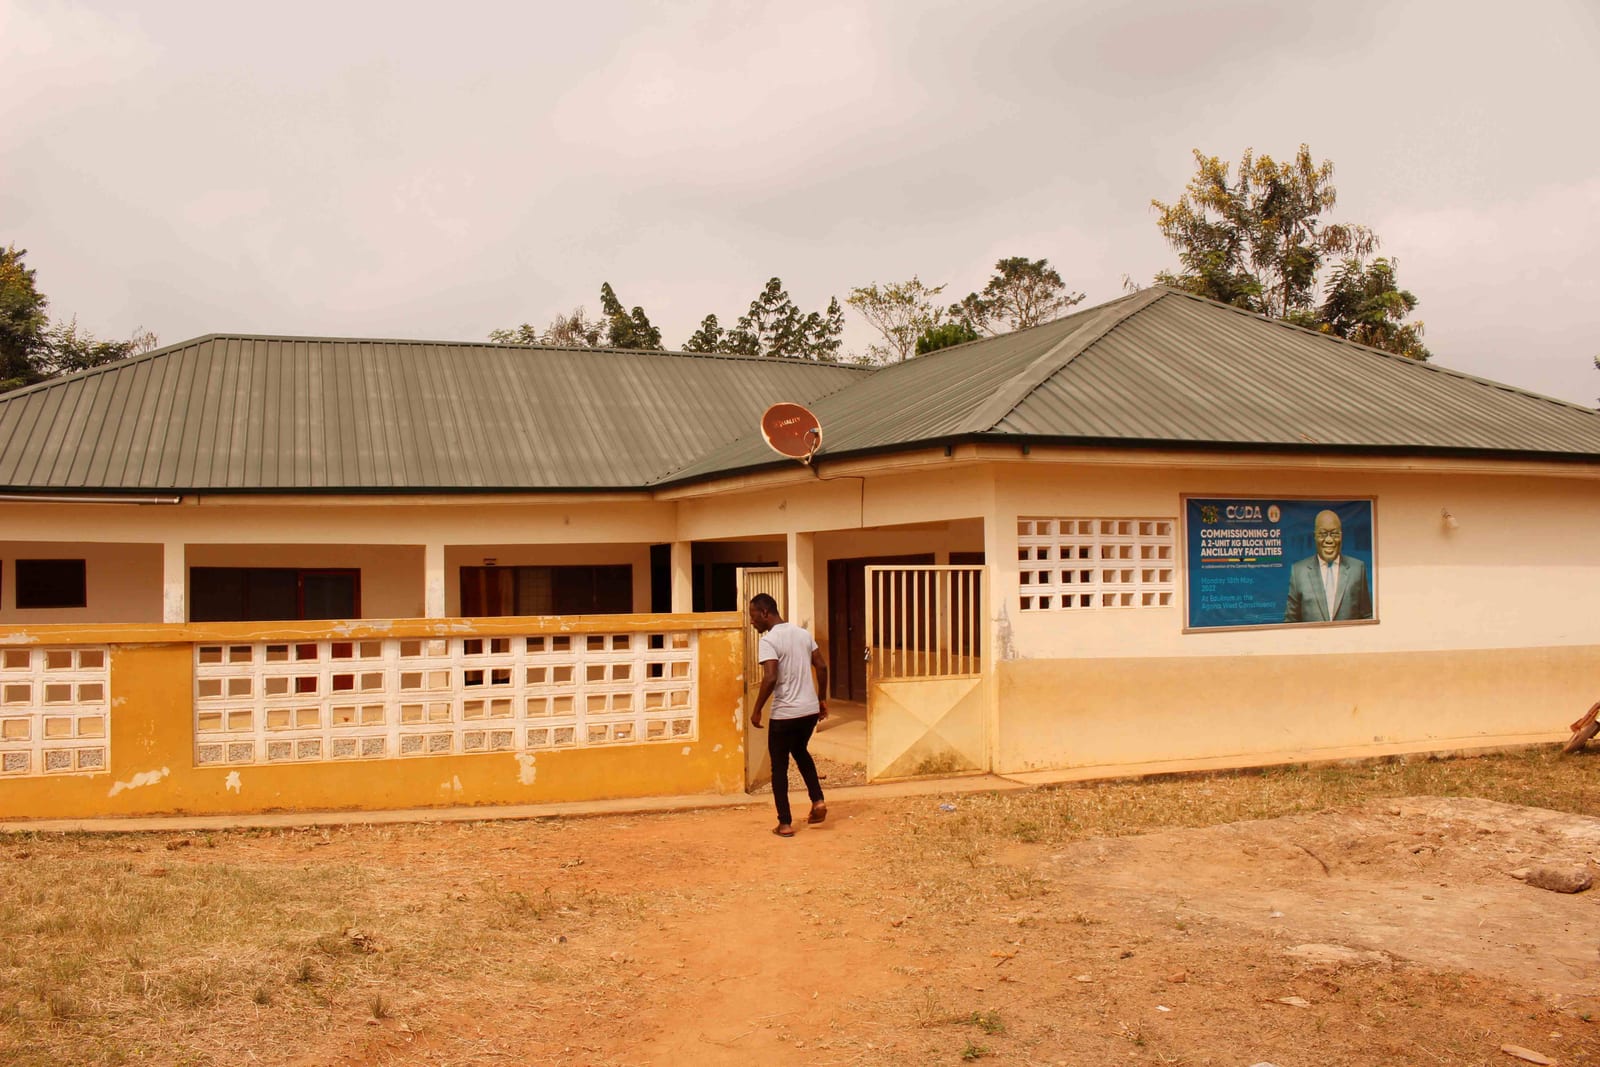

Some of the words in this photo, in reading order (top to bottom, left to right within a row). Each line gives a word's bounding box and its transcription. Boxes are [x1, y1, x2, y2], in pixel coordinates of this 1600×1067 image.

[1200, 529, 1268, 538] COMMISSIONING
[1270, 529, 1281, 538] OF
[1208, 539, 1230, 547] 2-UNIT
[1231, 539, 1241, 547] KG
[1200, 548, 1243, 557] ANCILLARY
[1245, 547, 1282, 556] FACILITIES
